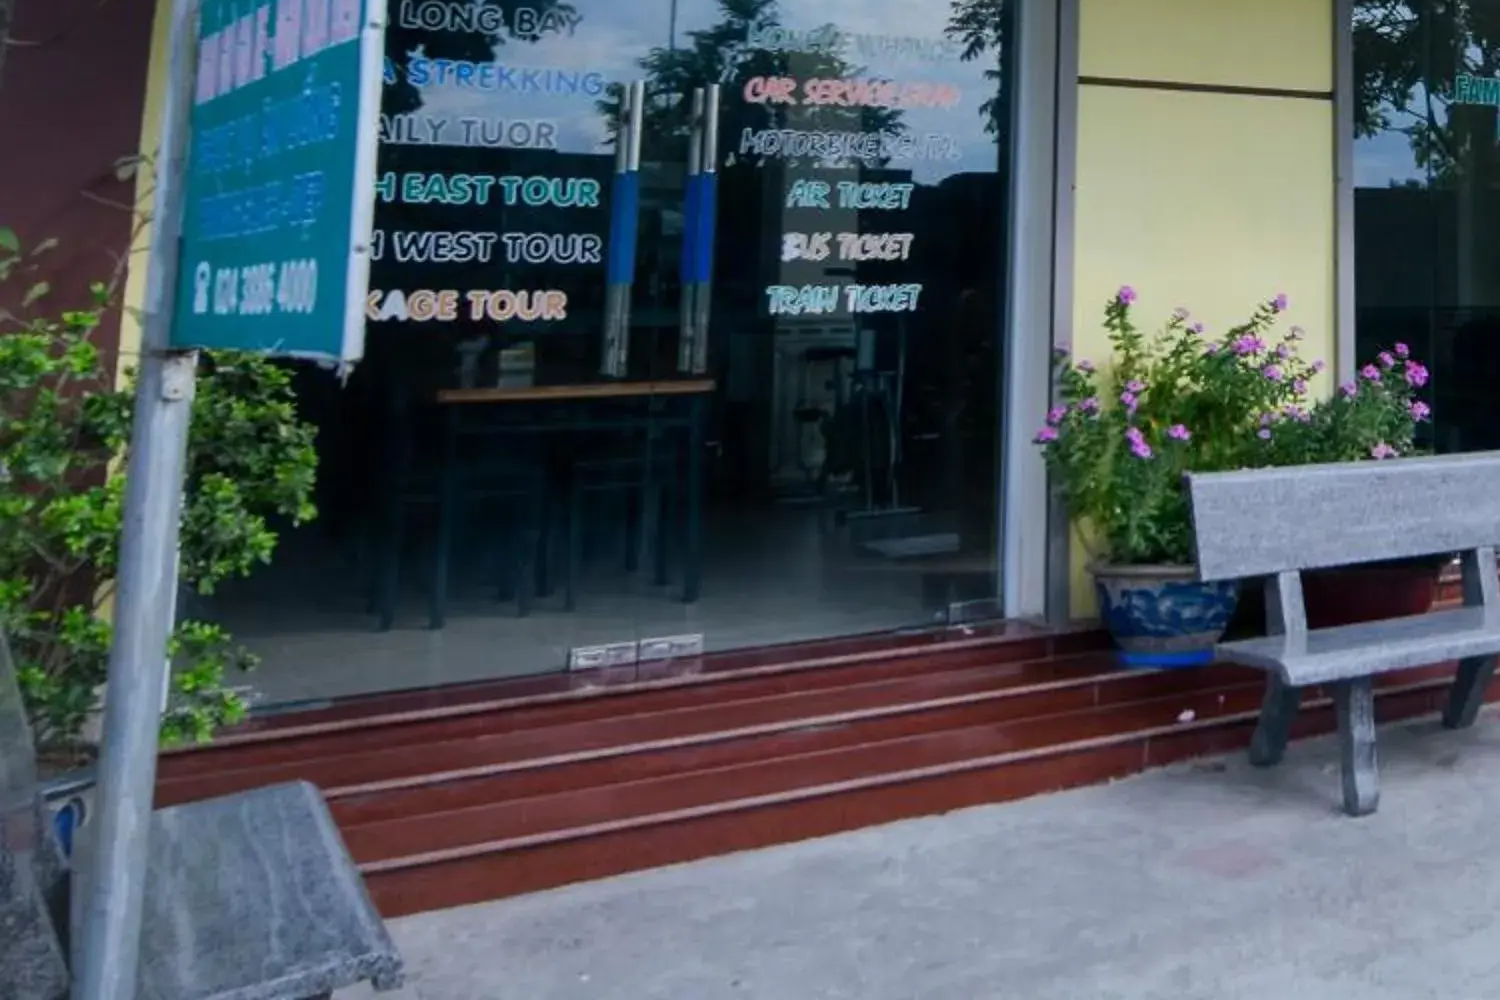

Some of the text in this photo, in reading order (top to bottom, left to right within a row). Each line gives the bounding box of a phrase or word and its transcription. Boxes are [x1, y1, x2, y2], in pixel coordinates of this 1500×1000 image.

[513, 6, 584, 36] BAY
[406, 57, 604, 96] STREKKING
[461, 118, 558, 147] TUOR
[403, 172, 495, 205] EAST
[498, 176, 600, 207] TOUR
[786, 179, 914, 210] AIR TICKET
[393, 231, 498, 263] WEST
[502, 232, 603, 264] TOUR
[781, 231, 914, 262] BUS TICKET
[467, 289, 567, 321] TOUR
[844, 283, 923, 313] TICKET
